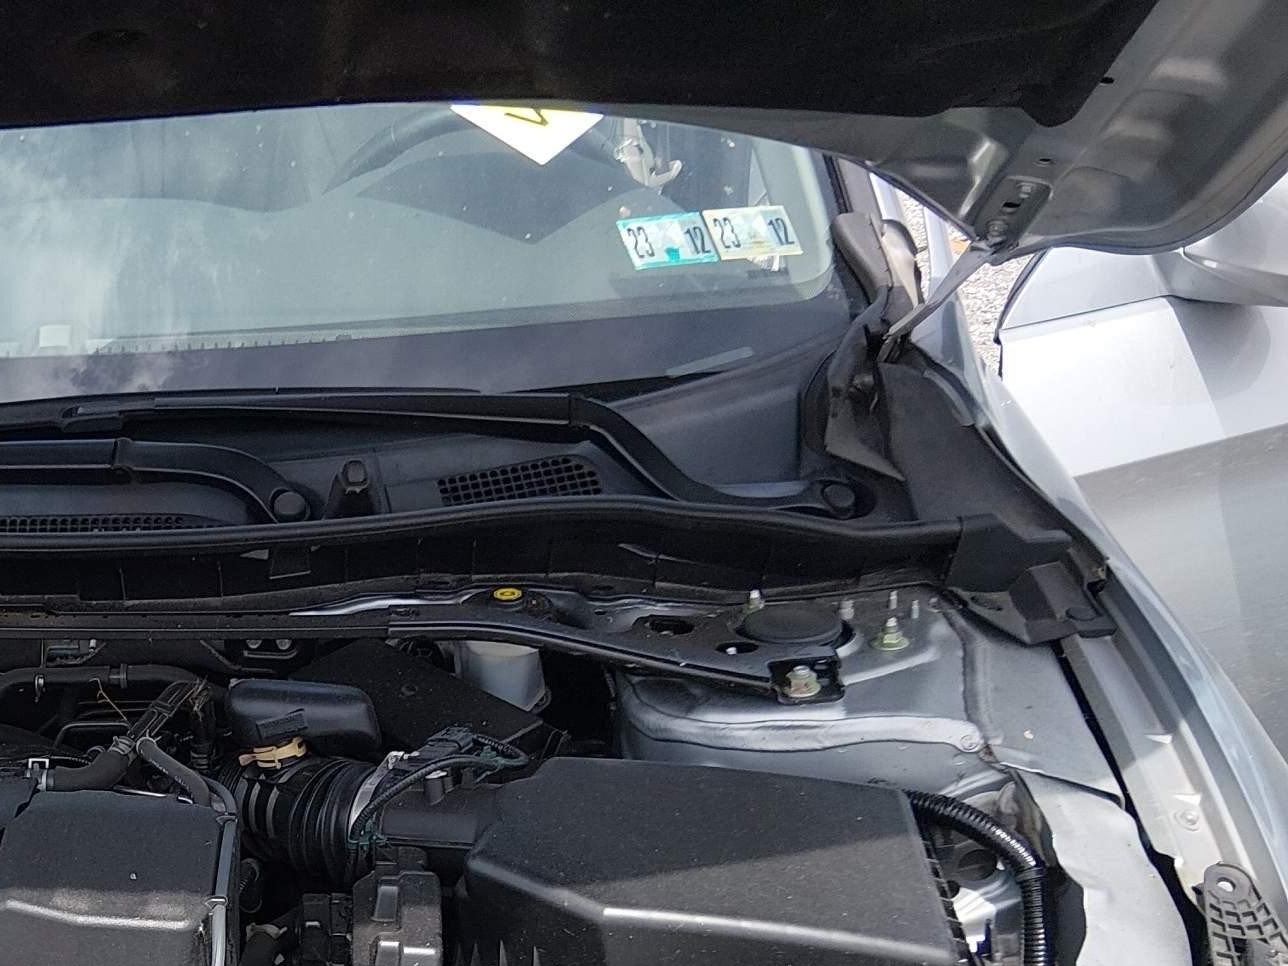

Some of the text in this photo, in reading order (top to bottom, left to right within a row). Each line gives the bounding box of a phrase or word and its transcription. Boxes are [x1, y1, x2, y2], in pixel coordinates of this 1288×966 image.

[626, 226, 711, 258] 23 12
[713, 217, 794, 248] 23 12
